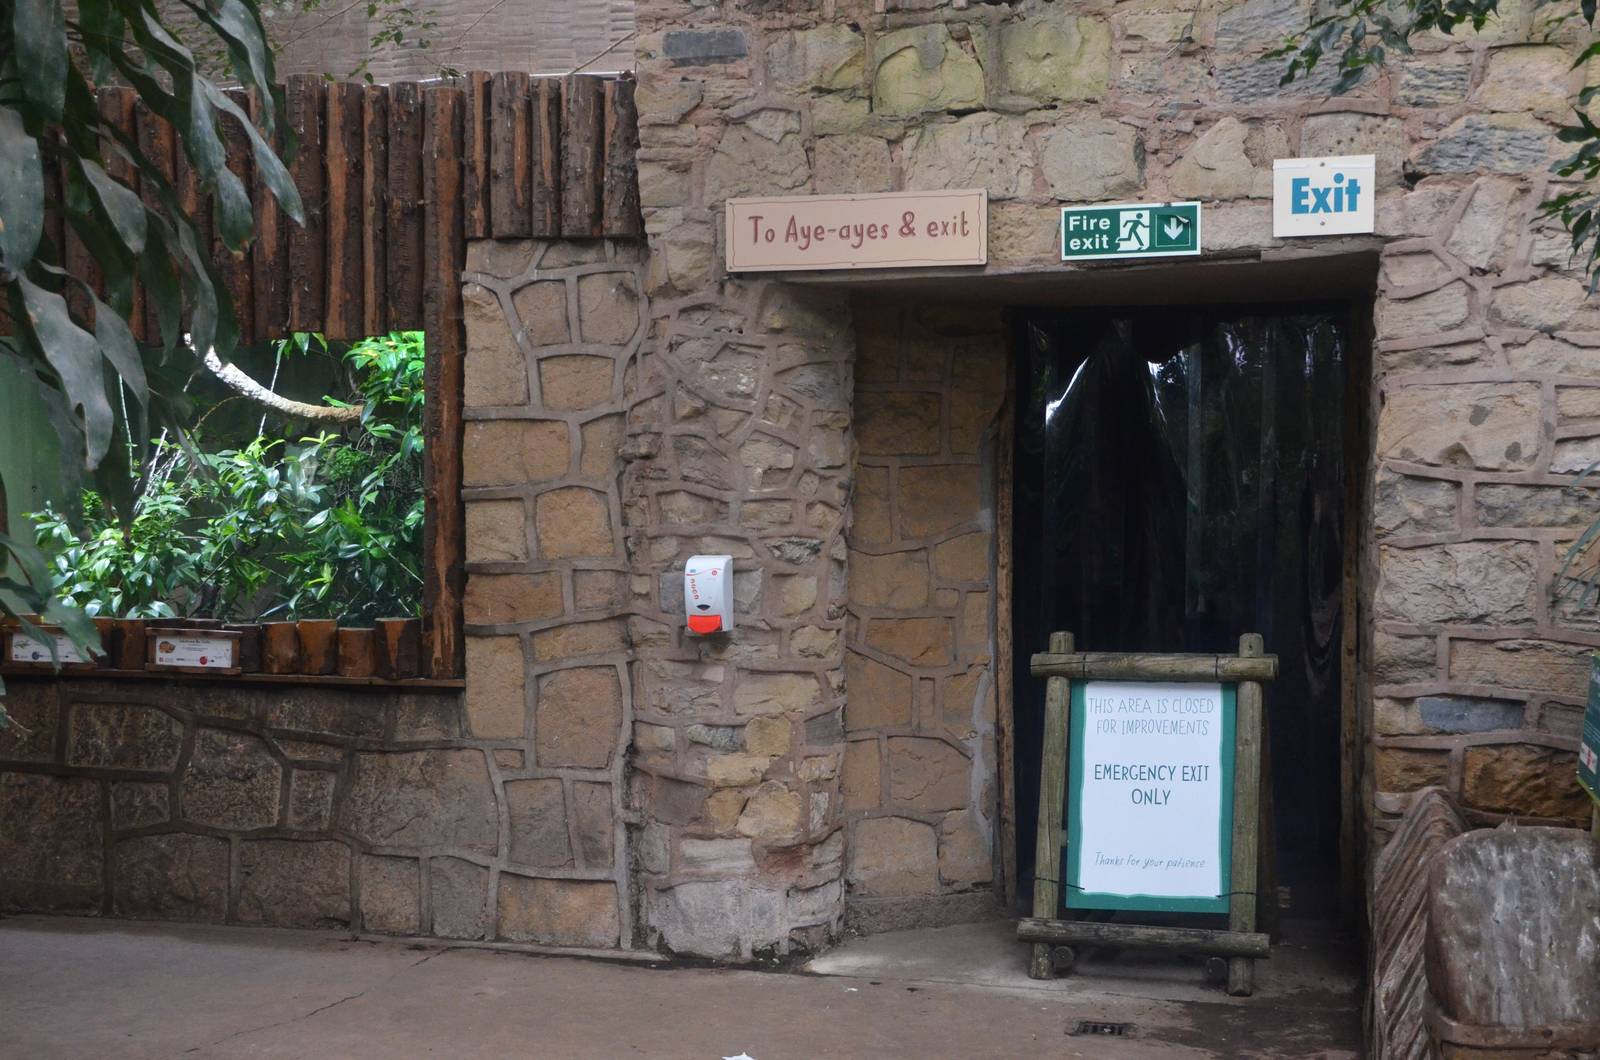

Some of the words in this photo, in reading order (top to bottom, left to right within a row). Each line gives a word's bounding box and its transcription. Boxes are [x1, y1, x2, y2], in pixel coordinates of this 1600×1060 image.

[1291, 173, 1360, 214] Exit
[748, 215, 775, 244] To
[785, 212, 889, 250] Aye-ayes
[898, 210, 917, 237] &
[927, 210, 970, 238] exit
[1069, 214, 1111, 232] Fire
[1070, 233, 1110, 251] exit
[1088, 698, 1113, 714] THIS
[1117, 698, 1152, 713] AREA
[1156, 698, 1169, 713] IS
[1172, 698, 1214, 714] CLOSED
[1097, 720, 1117, 735] FOR
[1121, 719, 1209, 736] IMPROVEMENTS
[1094, 764, 1176, 781] EMERGENCY
[1182, 765, 1209, 781] EXIT
[1131, 787, 1171, 805] ONLY
[1095, 852, 1126, 866] Thanks
[1127, 854, 1141, 866] for
[1142, 859, 1164, 870] your
[1166, 856, 1206, 869] patience
